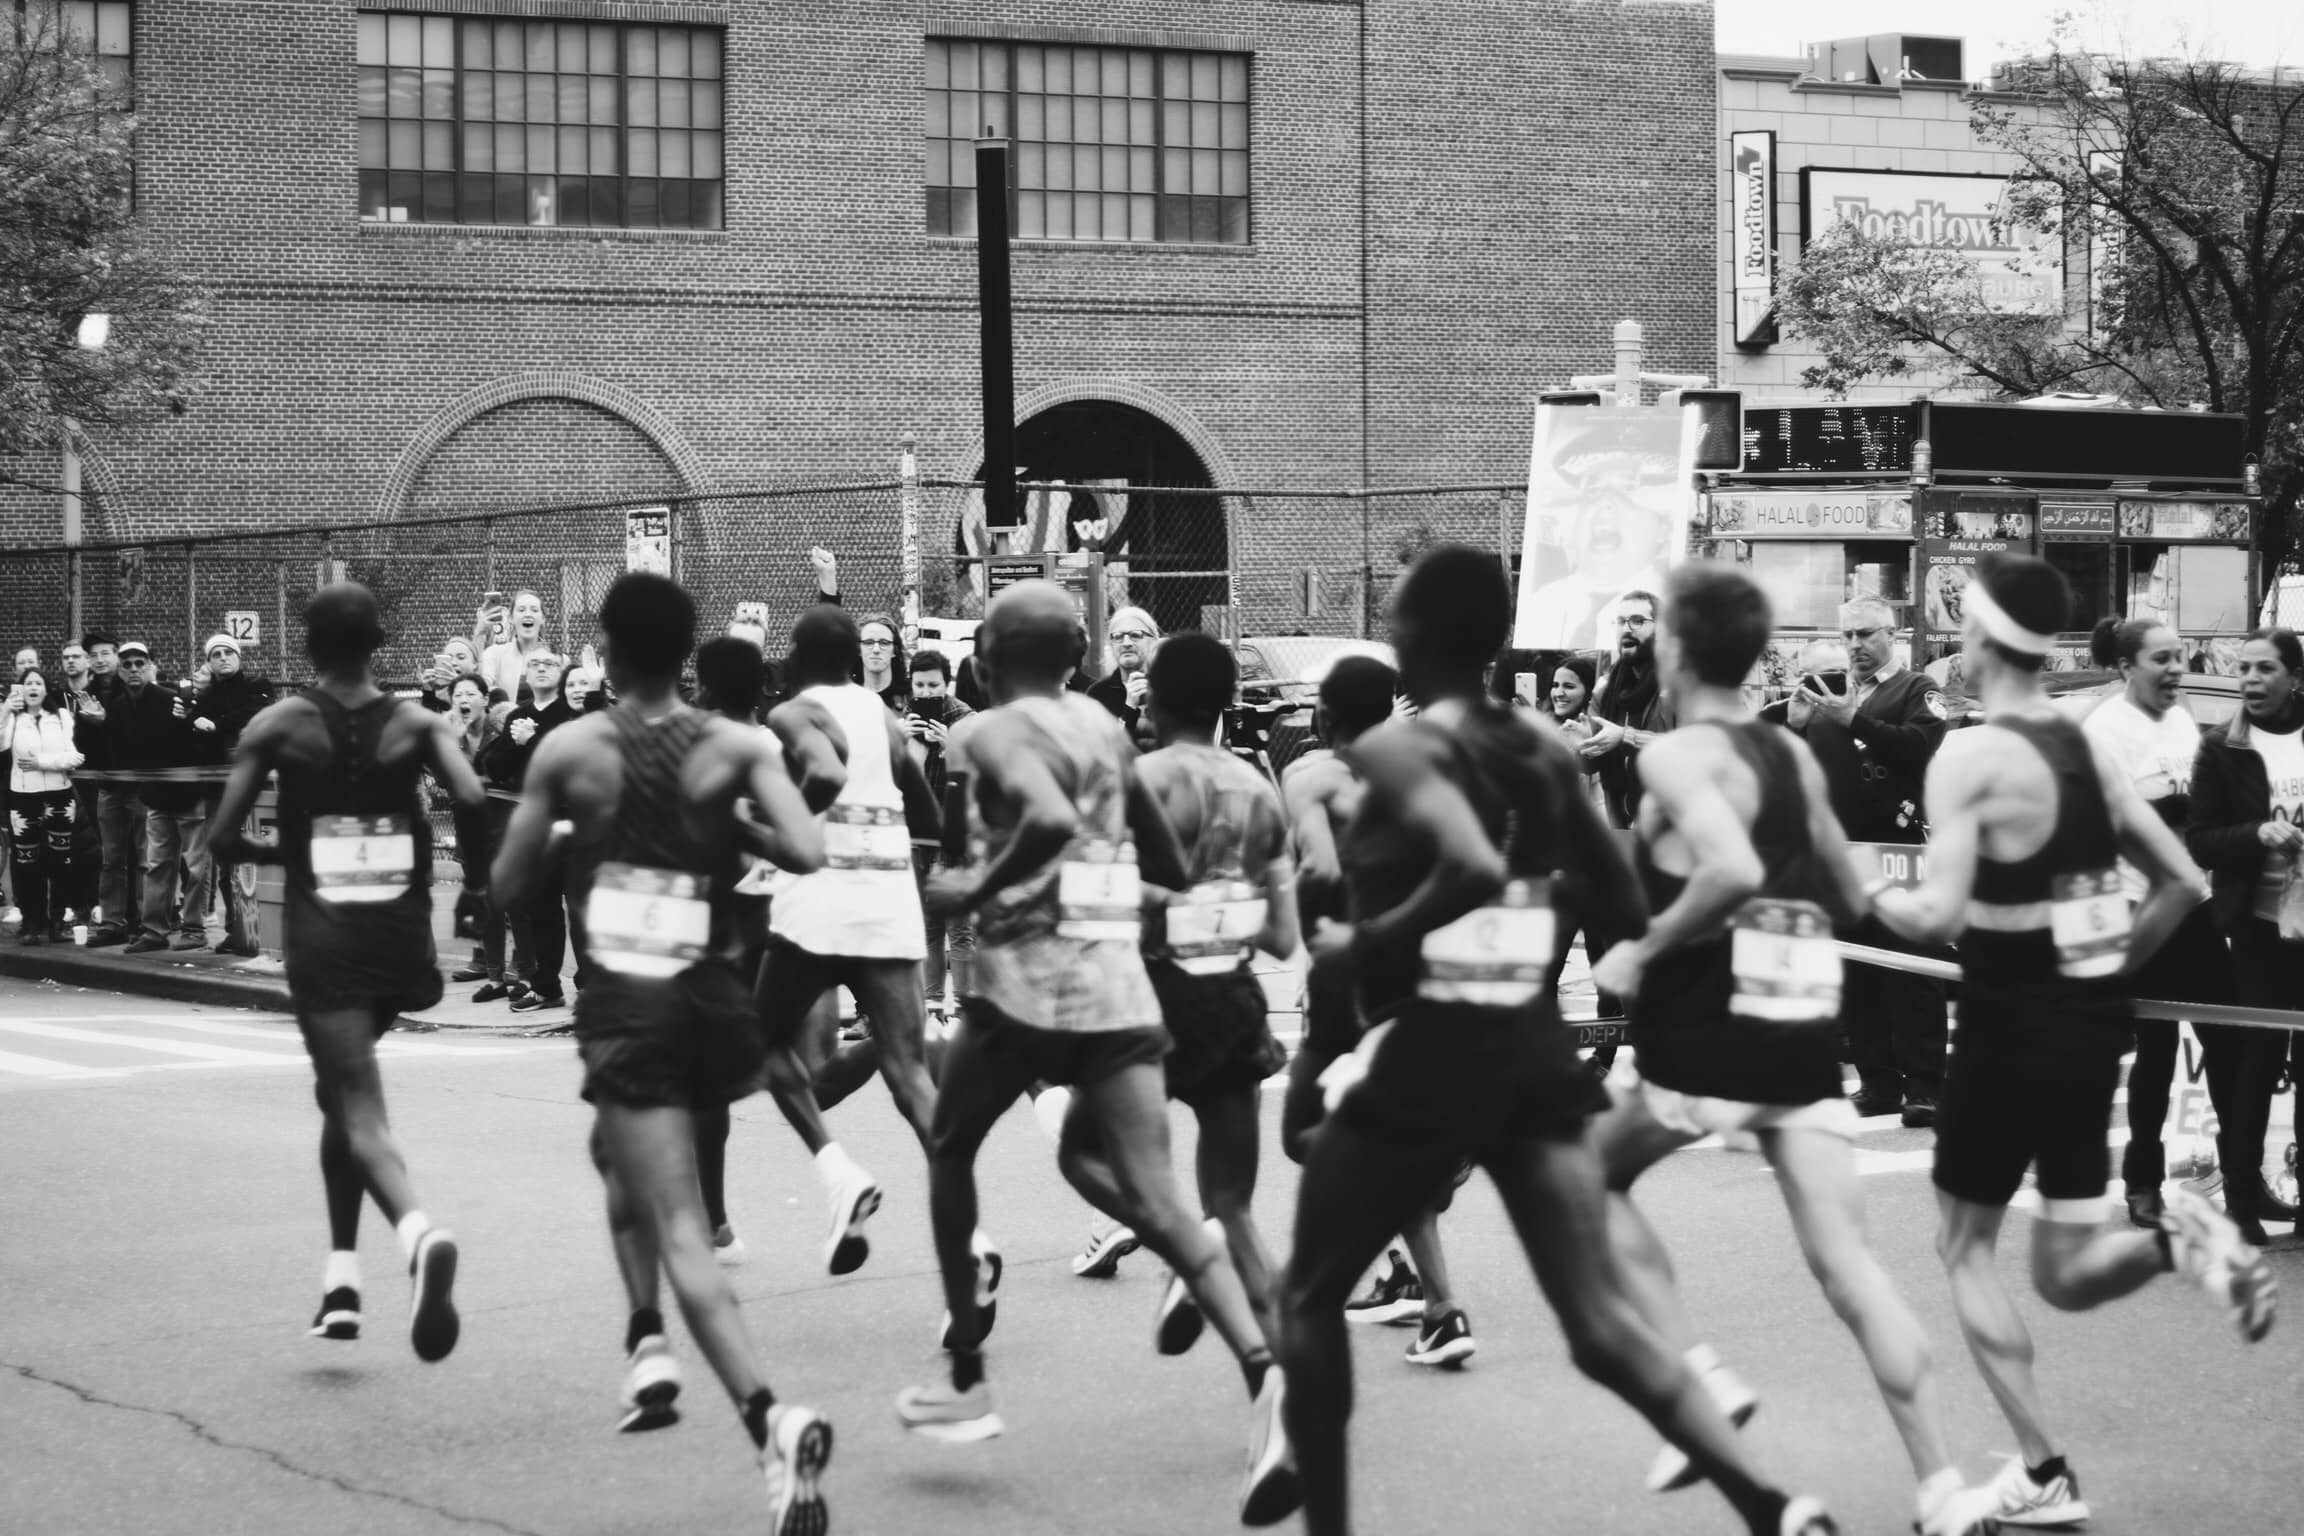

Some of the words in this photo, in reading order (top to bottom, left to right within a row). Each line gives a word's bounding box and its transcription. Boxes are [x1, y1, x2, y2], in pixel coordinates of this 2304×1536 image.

[1743, 161, 1764, 277] Foodtown
[1757, 506, 1804, 525] HALAL
[1823, 506, 1866, 525] FOOD
[1949, 542, 1980, 551] HALAL
[1981, 543, 2007, 552] FOOD
[231, 617, 254, 640] 12
[1882, 853, 1908, 880] DO
[1213, 909, 1225, 934] 7
